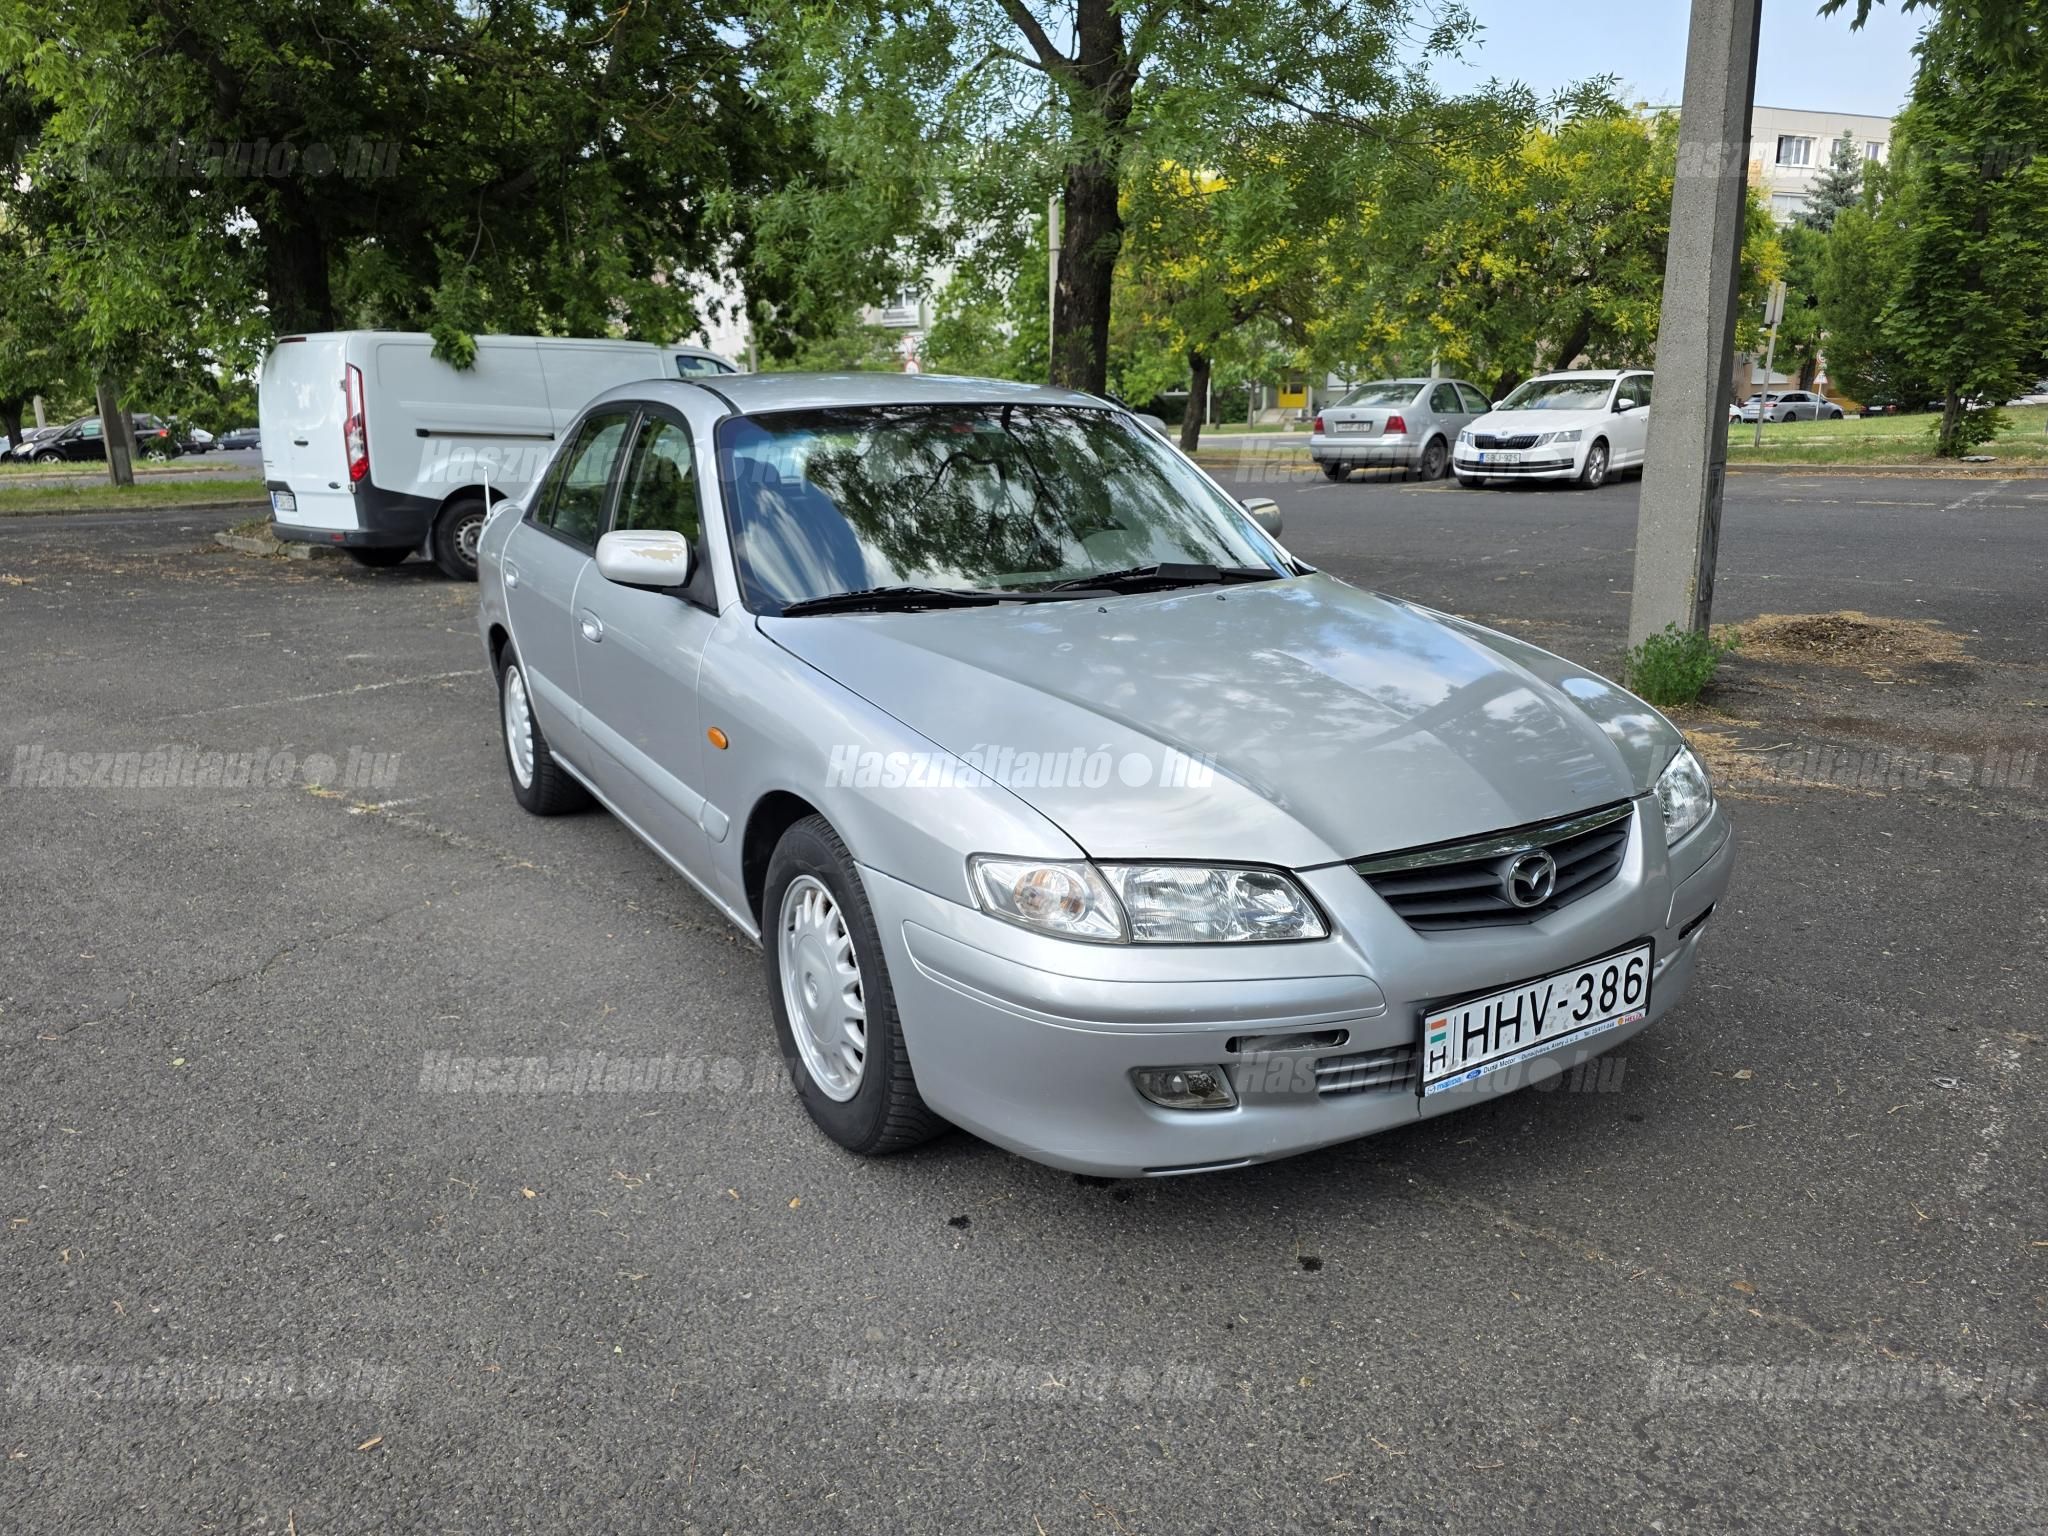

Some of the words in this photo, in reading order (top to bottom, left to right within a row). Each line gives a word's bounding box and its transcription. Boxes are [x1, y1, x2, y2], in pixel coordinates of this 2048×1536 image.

[1461, 957, 1644, 1062] HHV-386
[1429, 1046, 1447, 1073] H
[1500, 1056, 1516, 1068] Motor
